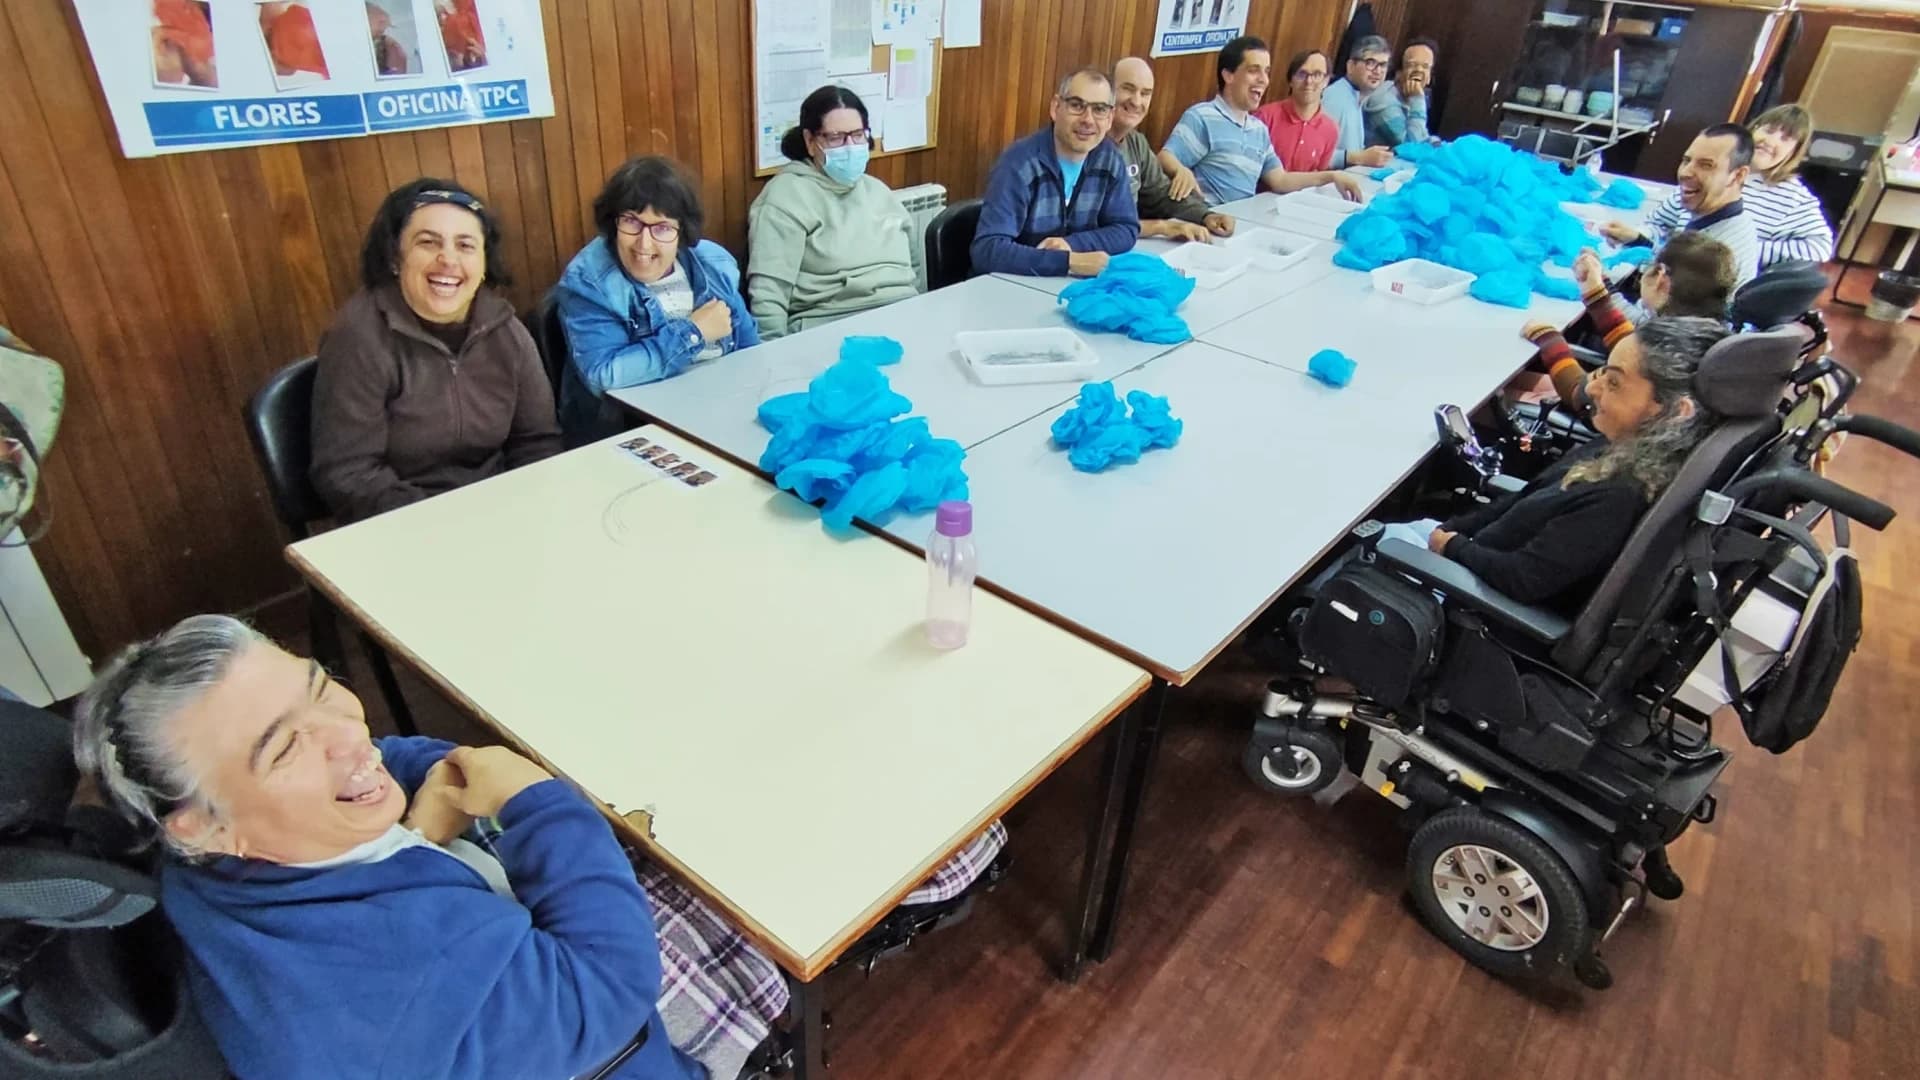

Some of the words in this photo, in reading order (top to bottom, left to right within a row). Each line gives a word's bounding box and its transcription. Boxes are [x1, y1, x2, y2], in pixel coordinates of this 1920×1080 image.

[212, 102, 321, 129] FLORES
[378, 90, 473, 117] OFICINA
[478, 84, 519, 107] TPC
